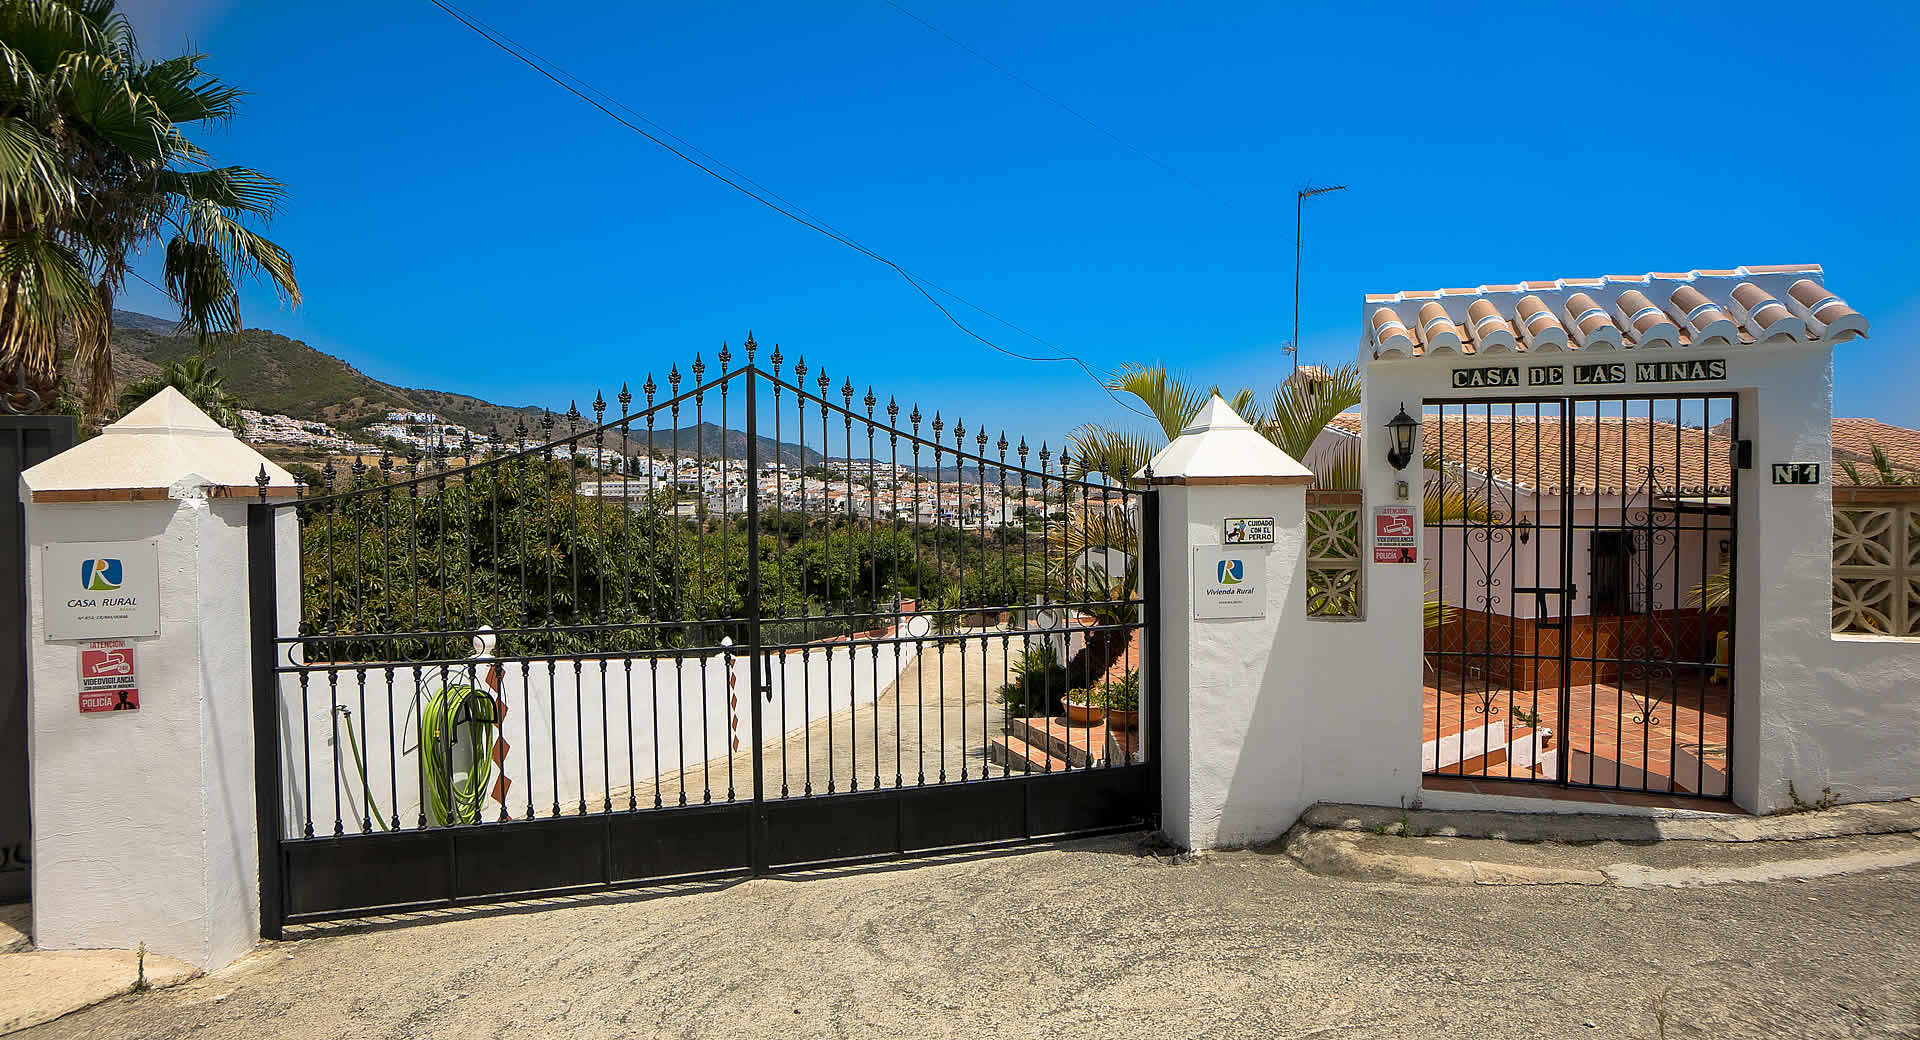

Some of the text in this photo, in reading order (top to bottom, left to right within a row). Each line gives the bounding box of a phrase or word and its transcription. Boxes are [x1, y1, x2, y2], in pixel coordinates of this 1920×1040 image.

[1453, 361, 1725, 387] CASA DE LAS MINAS
[1803, 465, 1817, 483] 1
[1206, 587, 1255, 596] Vivienda Rural
[67, 598, 137, 608] CASA RURAL
[83, 676, 135, 686] VIDEOVIGILANCIA
[82, 696, 113, 708] POLICÍA
